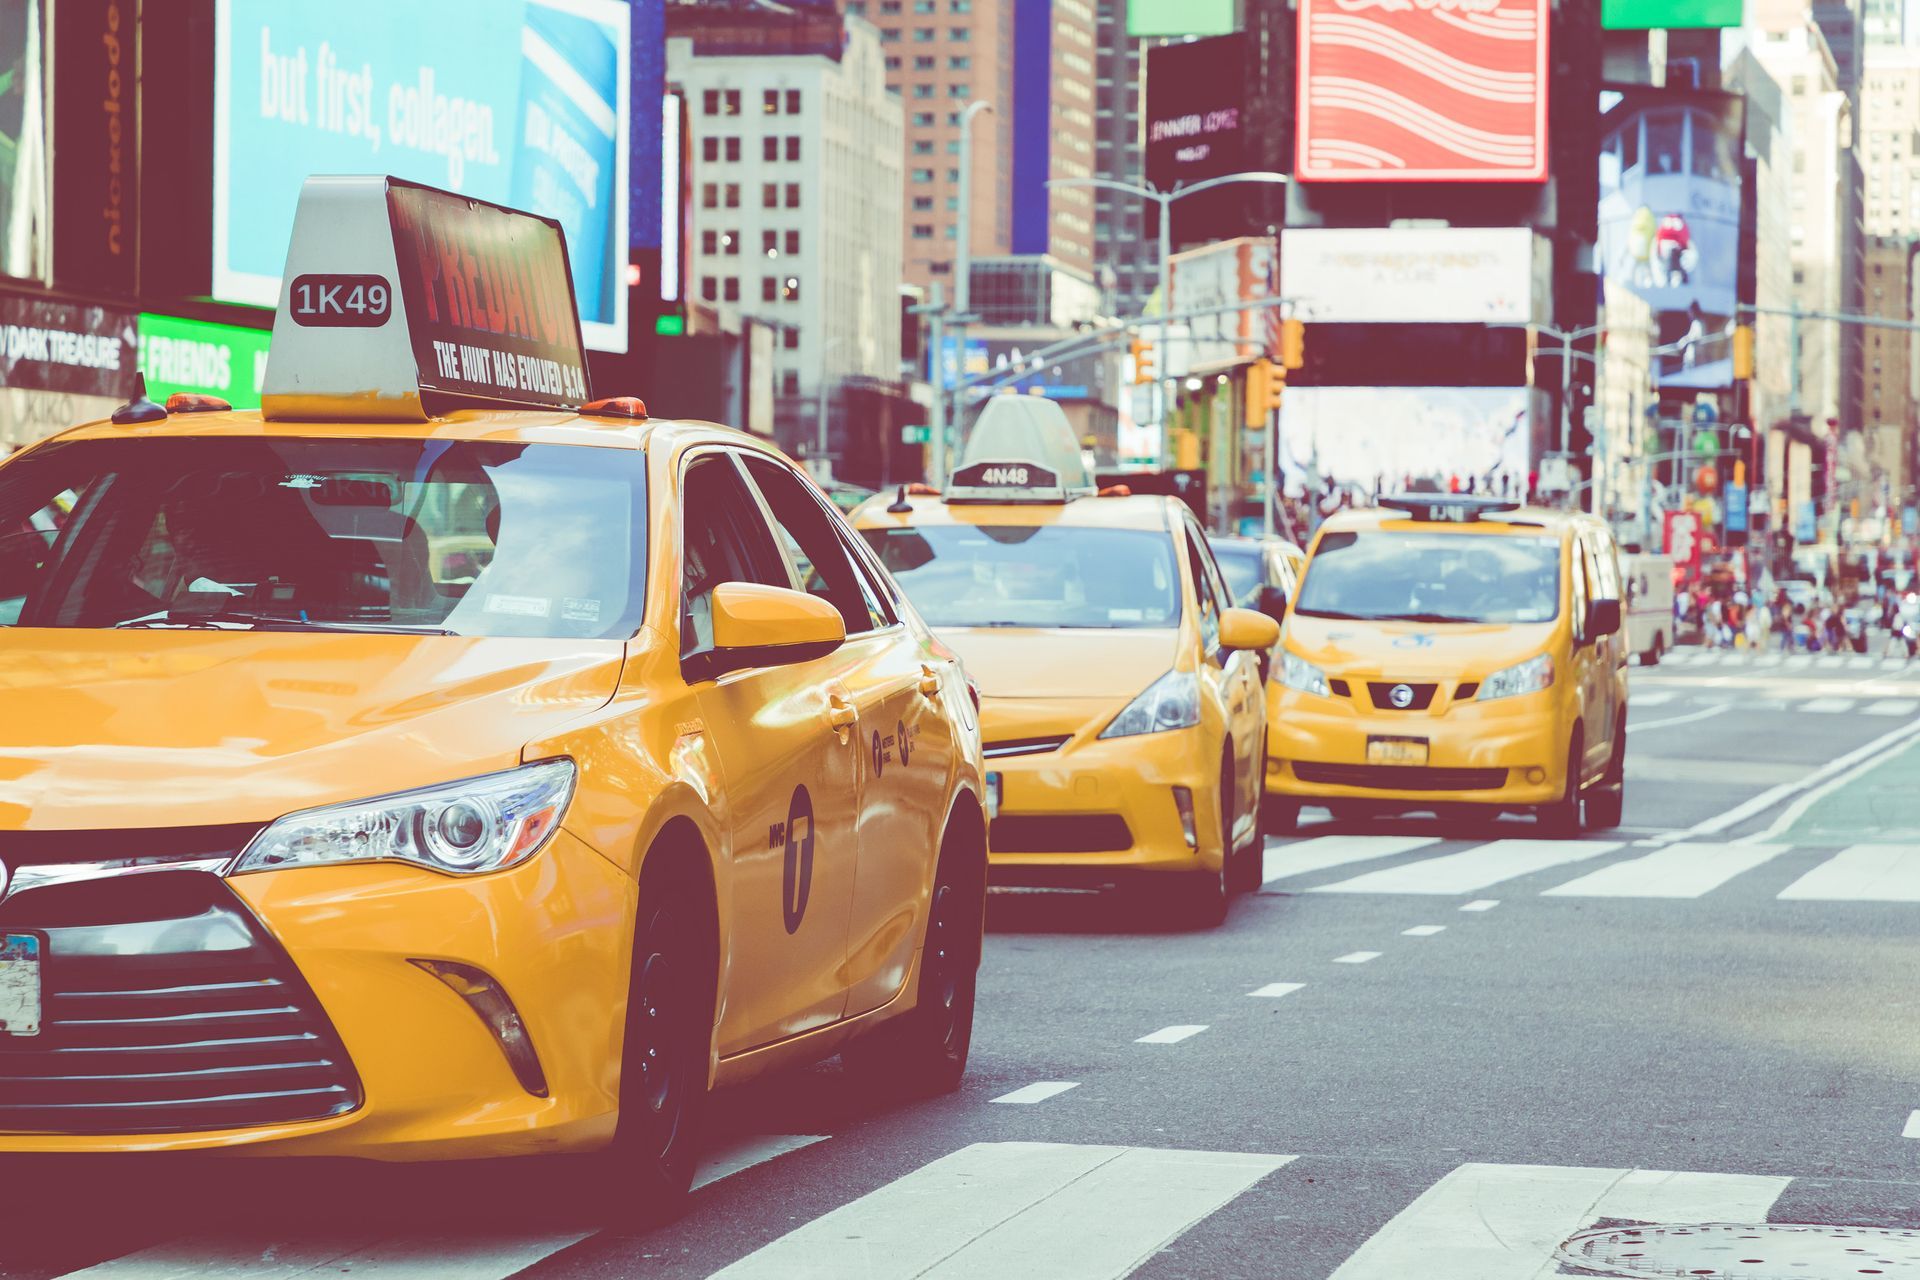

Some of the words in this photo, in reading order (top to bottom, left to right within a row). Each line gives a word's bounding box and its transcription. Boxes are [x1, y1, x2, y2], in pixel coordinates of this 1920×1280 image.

[260, 25, 309, 126] but
[316, 40, 381, 154] first,
[388, 66, 500, 191] collagen.
[297, 284, 388, 315] 1K49
[8, 325, 49, 361] DARK
[49, 329, 122, 371] TREASURE
[147, 335, 232, 391] FRIENDS
[433, 341, 460, 380] THE
[460, 345, 492, 385] HUNT
[493, 351, 517, 389] HAS
[517, 355, 563, 396] EVOLVED
[563, 364, 587, 400] 9.14
[982, 467, 1028, 485] 4N48
[769, 822, 785, 849] NYC
